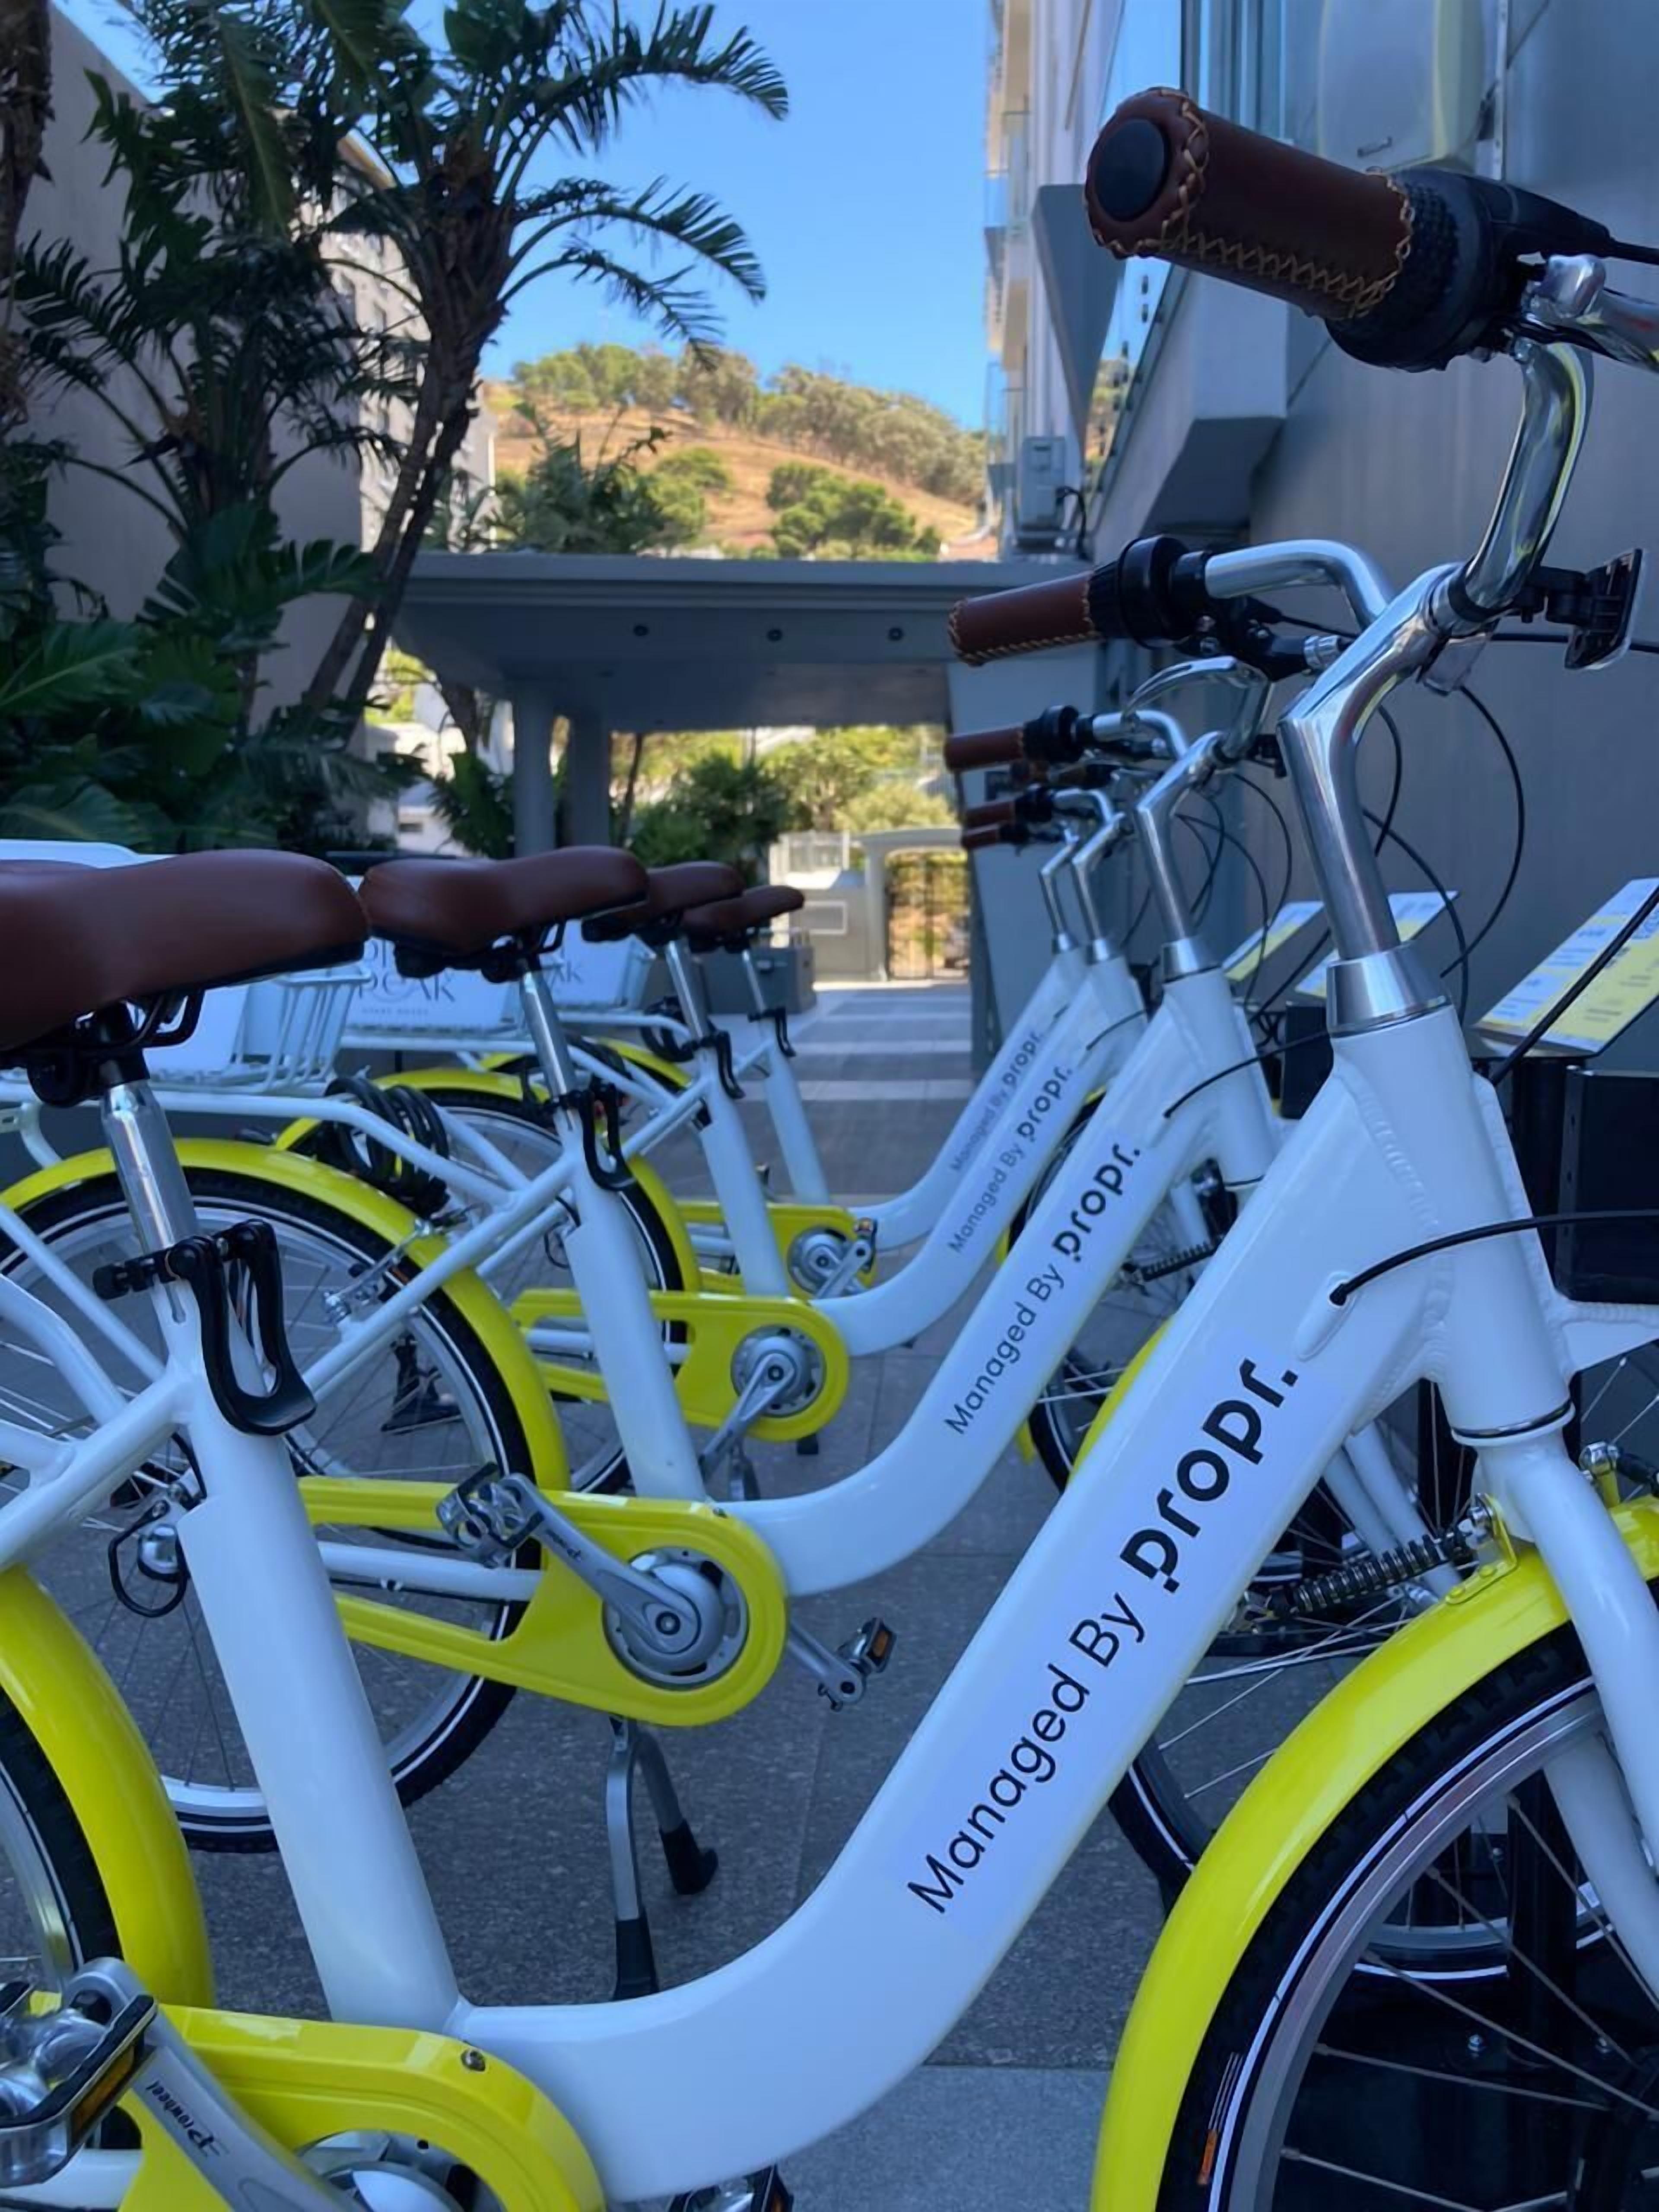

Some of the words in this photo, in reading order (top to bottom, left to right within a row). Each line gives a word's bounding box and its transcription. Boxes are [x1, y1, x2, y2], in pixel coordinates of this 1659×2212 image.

[947, 1167, 1007, 1252] Managed
[999, 1143, 1026, 1168] By
[1016, 1066, 1072, 1143] propr.
[949, 1106, 996, 1172] Managed
[989, 1088, 1010, 1109] By
[944, 1301, 1036, 1434] Managed
[1026, 1264, 1065, 1302] By
[1052, 1143, 1141, 1263] propr.
[907, 1663, 1091, 1914] Managed
[1069, 1593, 1145, 1668] By
[1119, 1358, 1299, 1594] propr.
